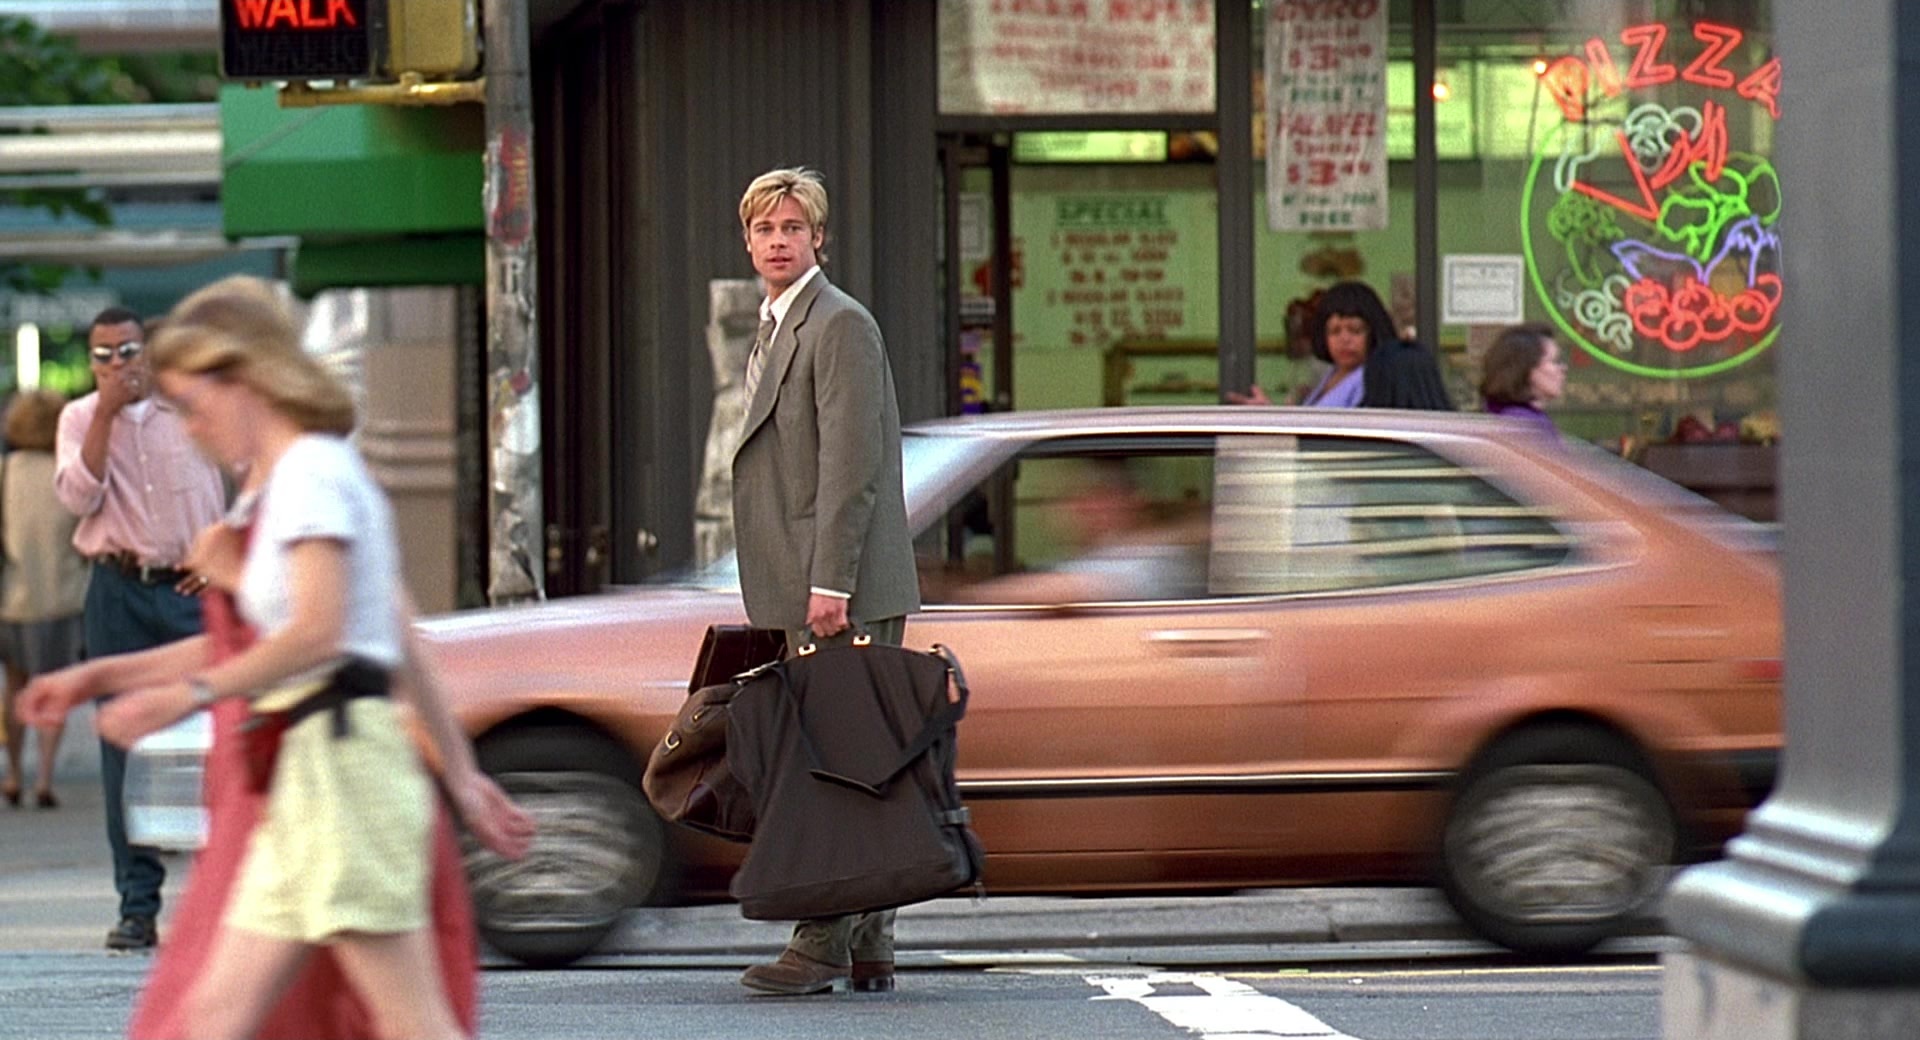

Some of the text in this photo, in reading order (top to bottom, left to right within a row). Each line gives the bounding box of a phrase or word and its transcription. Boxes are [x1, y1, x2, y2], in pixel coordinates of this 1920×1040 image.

[236, 0, 355, 28] WALK
[1539, 21, 1781, 122] PIZZA
[1058, 199, 1166, 221] SPECIAL
